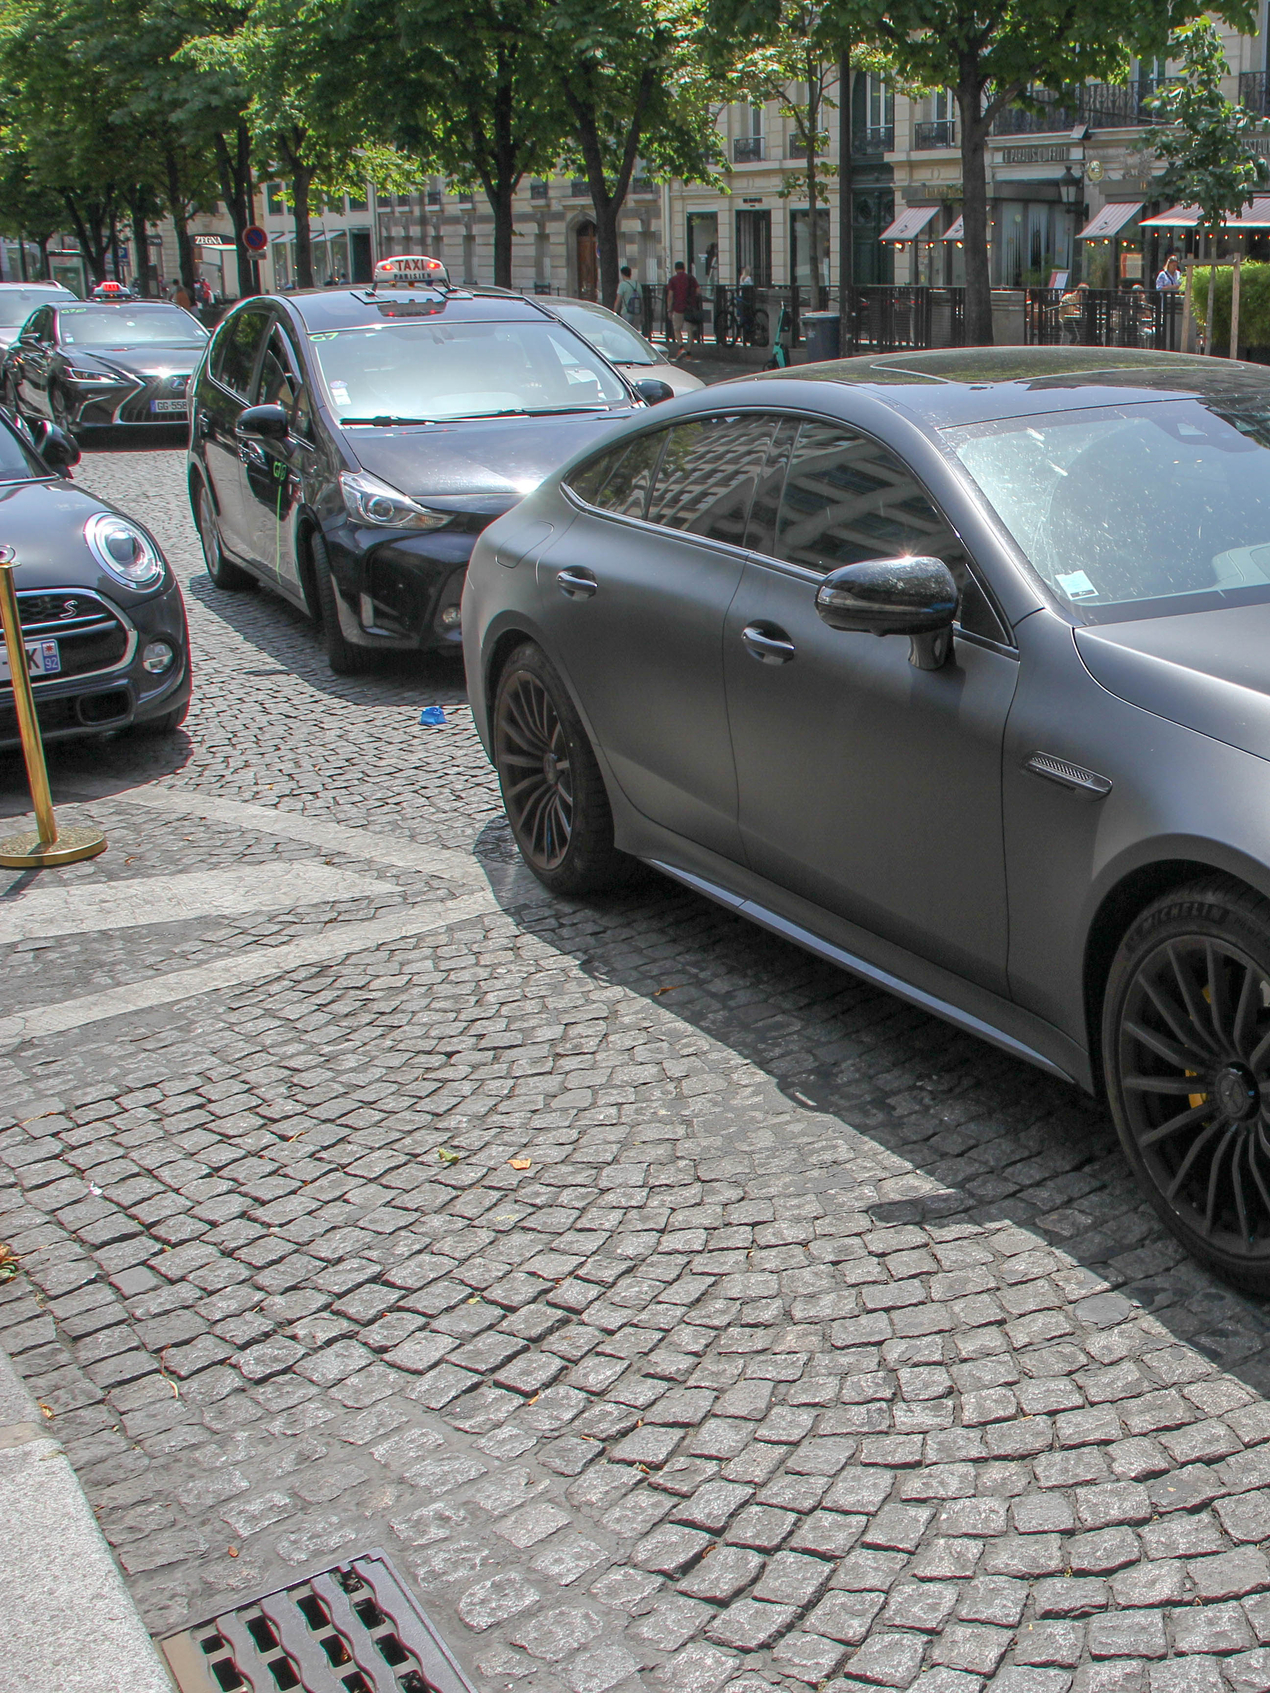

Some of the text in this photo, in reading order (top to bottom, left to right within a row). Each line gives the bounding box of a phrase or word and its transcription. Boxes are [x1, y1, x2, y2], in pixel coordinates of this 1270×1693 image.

[194, 236, 223, 245] ZEGNA
[396, 259, 425, 272] TAXI
[310, 332, 339, 342] G7
[157, 402, 187, 411] GG-558
[60, 600, 78, 619] S
[45, 657, 58, 669] 92
